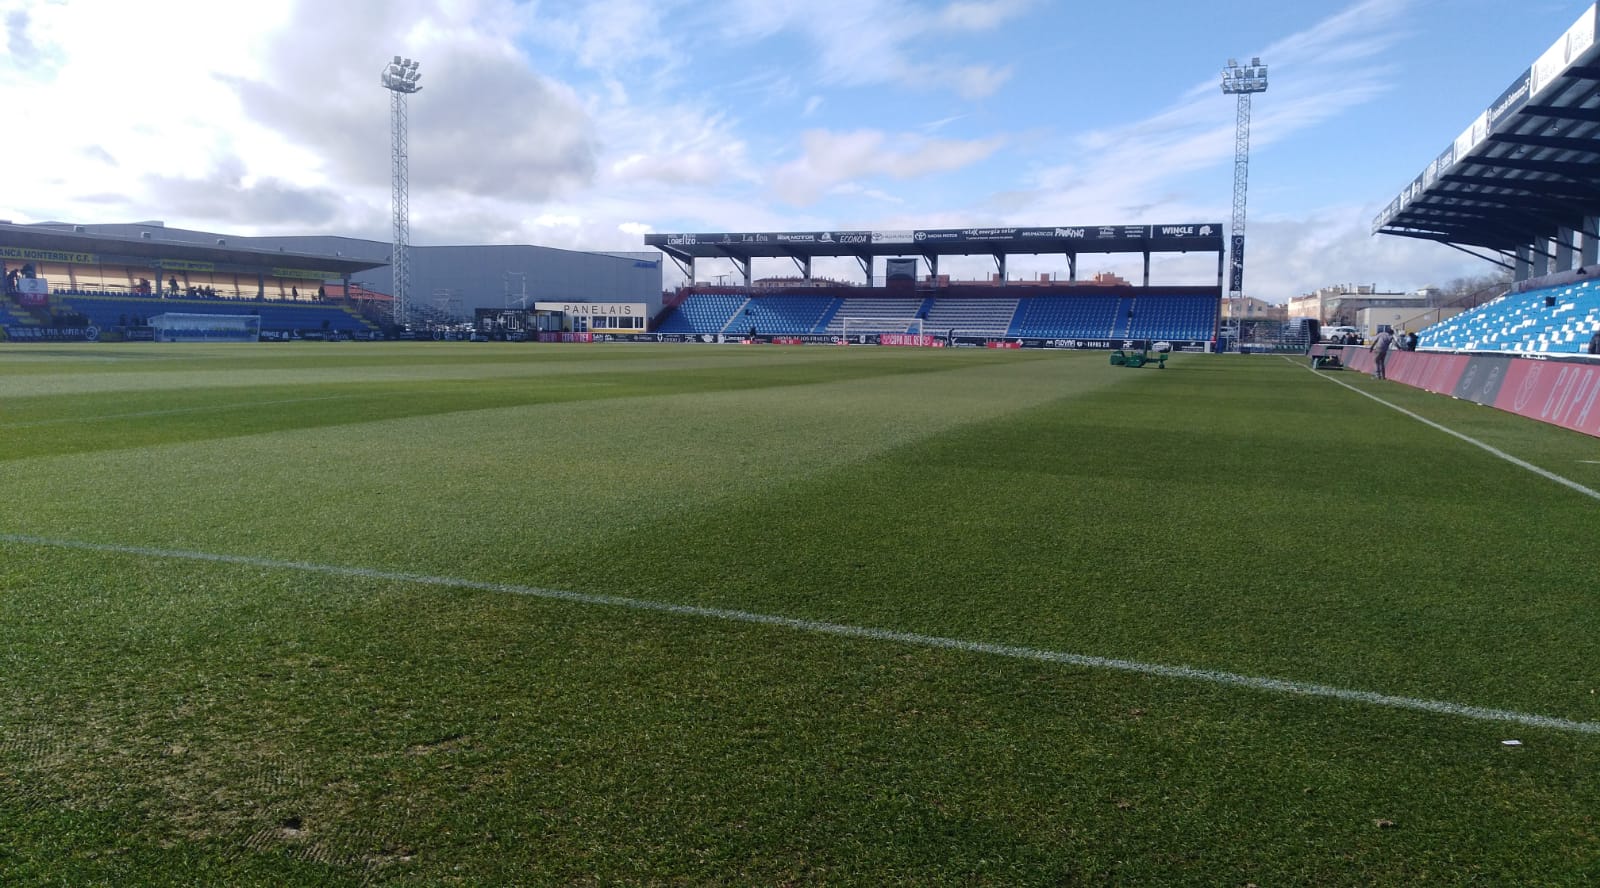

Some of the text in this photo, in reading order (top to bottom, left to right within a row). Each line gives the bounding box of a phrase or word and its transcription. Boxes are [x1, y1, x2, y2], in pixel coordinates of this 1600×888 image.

[1162, 226, 1194, 235] WINCLE
[24, 250, 74, 261] MONTERREY
[76, 254, 90, 262] C.F.
[563, 305, 631, 315] PANELAIS
